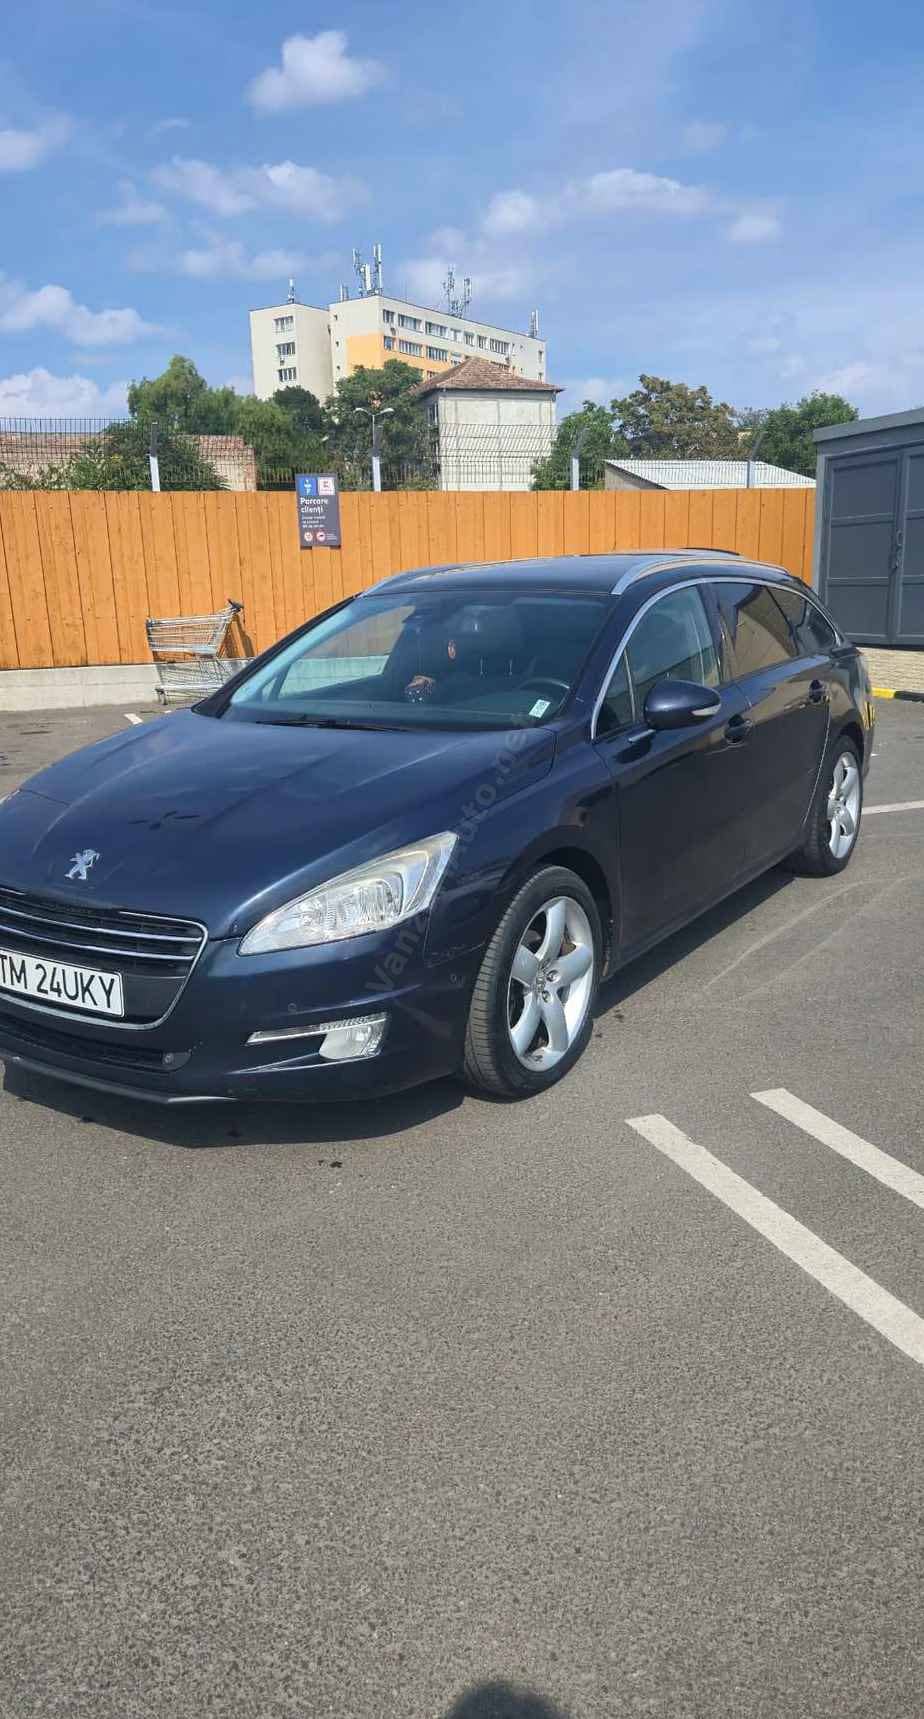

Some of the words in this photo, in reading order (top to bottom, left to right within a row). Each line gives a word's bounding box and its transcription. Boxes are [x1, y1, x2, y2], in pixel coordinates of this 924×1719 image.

[300, 497, 329, 505] Parcare
[0, 954, 28, 990] TM
[35, 963, 115, 1009] 24UKY
